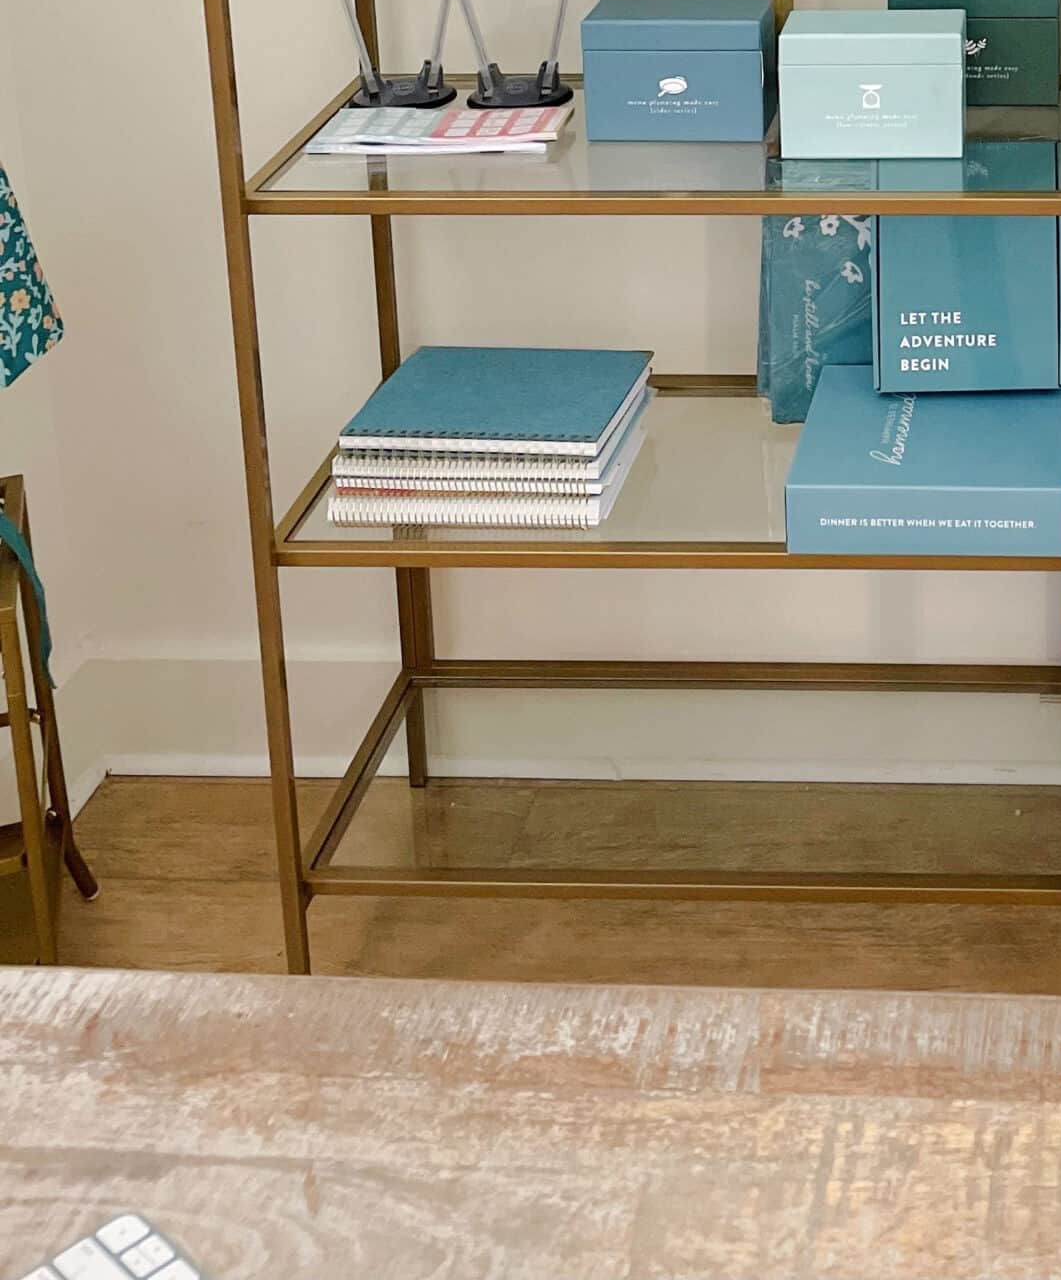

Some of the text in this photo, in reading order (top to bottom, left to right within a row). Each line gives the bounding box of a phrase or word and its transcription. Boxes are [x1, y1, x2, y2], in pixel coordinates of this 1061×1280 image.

[900, 311, 962, 325] LET THE
[899, 334, 998, 349] ADVENTURE
[900, 358, 950, 372] BEGIN
[869, 392, 917, 466] homemad
[819, 517, 1038, 530] DINNER IS BETTER WHEN WE EAT IT TOGETHER.
